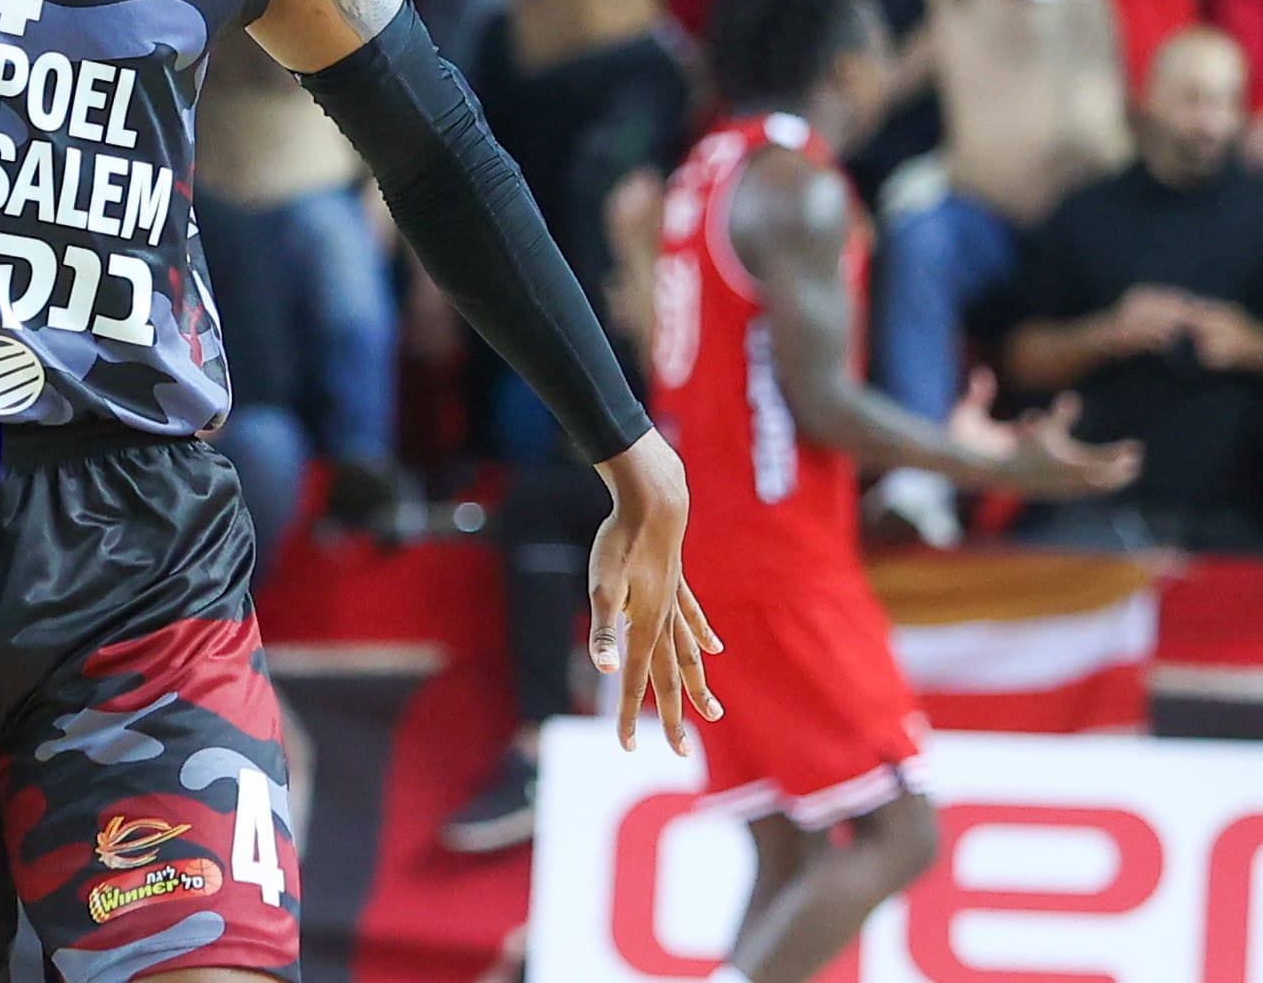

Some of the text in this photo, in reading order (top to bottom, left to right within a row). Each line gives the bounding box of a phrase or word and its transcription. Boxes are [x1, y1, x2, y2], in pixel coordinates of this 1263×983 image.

[232, 768, 285, 907] 4
[146, 866, 175, 884] ליגת
[181, 874, 204, 889] סל
[100, 879, 179, 913] Winner
